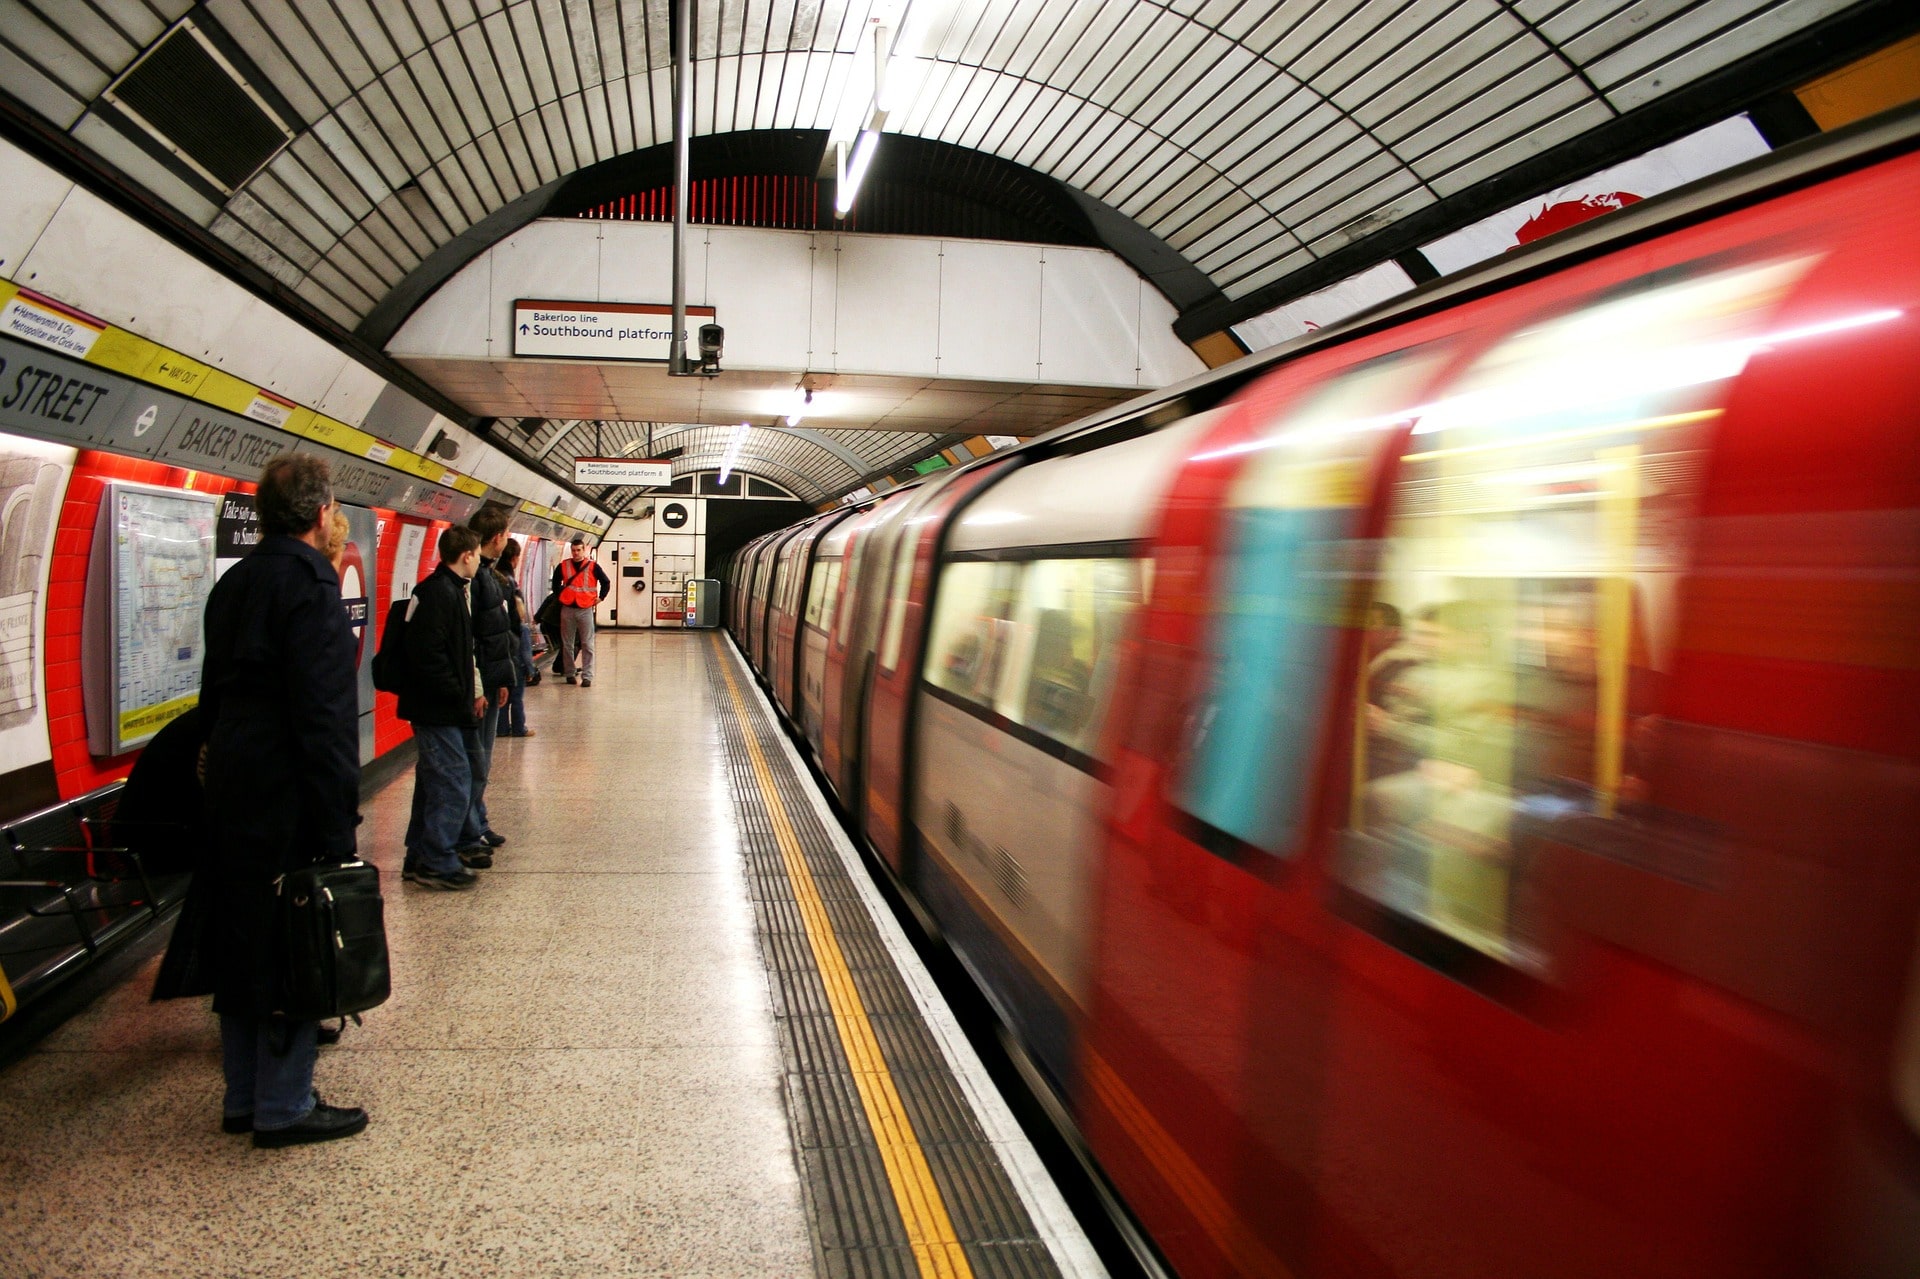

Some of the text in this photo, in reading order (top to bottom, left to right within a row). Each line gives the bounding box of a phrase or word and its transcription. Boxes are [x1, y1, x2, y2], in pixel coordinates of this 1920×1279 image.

[20, 307, 58, 328] Hammersmith
[63, 324, 76, 337] City
[533, 313, 598, 323] Bakerloo line
[10, 319, 86, 353] Metropolitan and Circle lines
[533, 325, 613, 338] Southbound
[618, 328, 673, 341] platform
[169, 367, 198, 385] WAY OUT
[2, 365, 110, 426] STREET
[178, 417, 285, 468] BAKER STREET
[223, 501, 239, 519] Take
[233, 530, 241, 545] to
